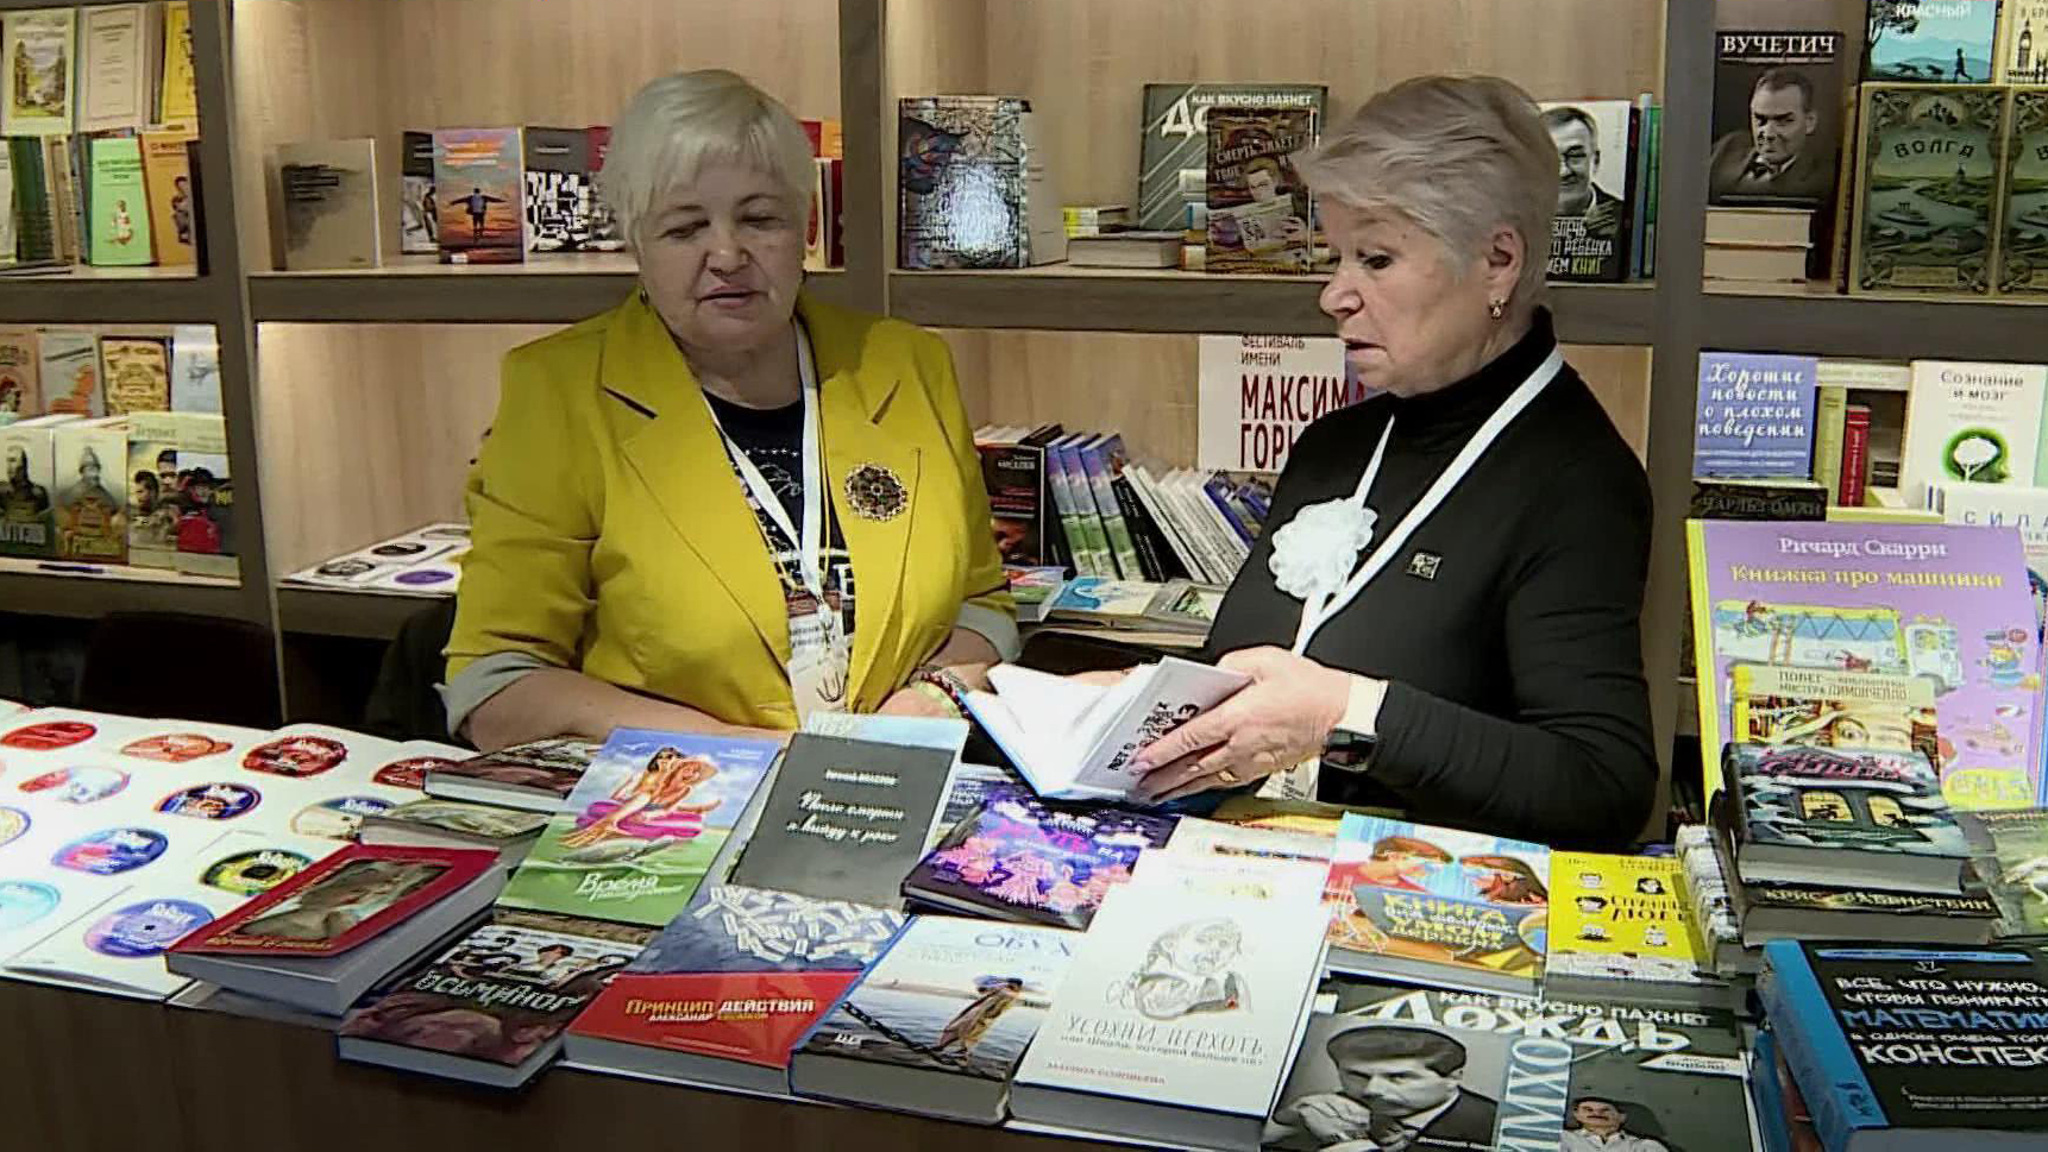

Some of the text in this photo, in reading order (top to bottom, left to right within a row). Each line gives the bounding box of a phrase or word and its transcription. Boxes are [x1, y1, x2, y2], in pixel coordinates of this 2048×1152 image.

[1722, 35, 1835, 53] ВУЧЕТИЧ
[1192, 94, 1312, 106] КАК ВКУСНО ПАХНЕТ
[1893, 137, 1976, 159] ВОЛГА
[1240, 352, 1281, 366] ИМЕНИ
[1707, 362, 1804, 391] Хорошие
[1940, 370, 2024, 387] Сознание
[1711, 385, 1798, 401] новости
[1704, 405, 1802, 419] о плохом
[1699, 419, 1806, 447] поведении
[1779, 536, 1948, 560] Ричард Скарри
[1729, 564, 2005, 589] Книжка про машинки
[1897, 978, 1949, 990] ЧТО
[719, 998, 816, 1014] ДЕЙСТВИЯ
[1843, 992, 1925, 1005] ЧТОБЫ
[1438, 991, 1712, 1027] КАК ВКУСНО ПАХНЕТ
